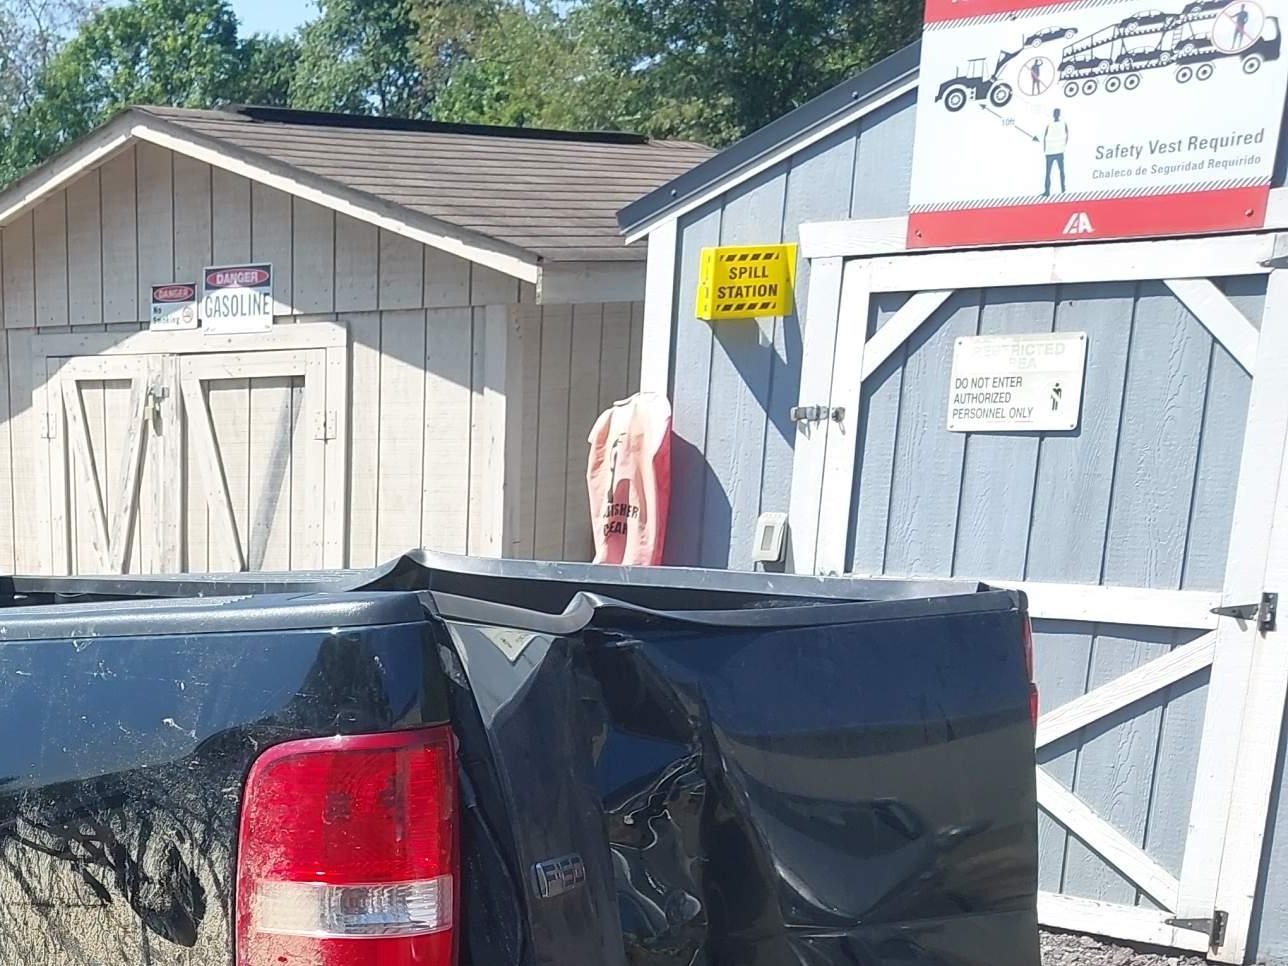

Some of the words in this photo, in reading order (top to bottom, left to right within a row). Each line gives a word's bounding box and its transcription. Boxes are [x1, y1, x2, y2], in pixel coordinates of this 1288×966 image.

[1095, 143, 1143, 160] Safety
[1148, 139, 1183, 155] Vest
[1187, 128, 1265, 152] Required
[1092, 168, 1132, 180] Chaleco
[1135, 166, 1148, 176] de
[1150, 160, 1205, 175] Seguridad
[1207, 154, 1261, 169] Requirido
[215, 270, 259, 285] DANGER
[728, 265, 769, 280] SPILL
[717, 283, 778, 300] STATION
[205, 292, 271, 318] GASOLINE
[955, 377, 969, 390] DO
[970, 376, 991, 390] NOT
[992, 376, 1023, 389] ENTER
[953, 391, 1012, 405] AUTHORIZED
[952, 407, 1006, 420] PERSONNEL
[1008, 406, 1034, 419] ONLY
